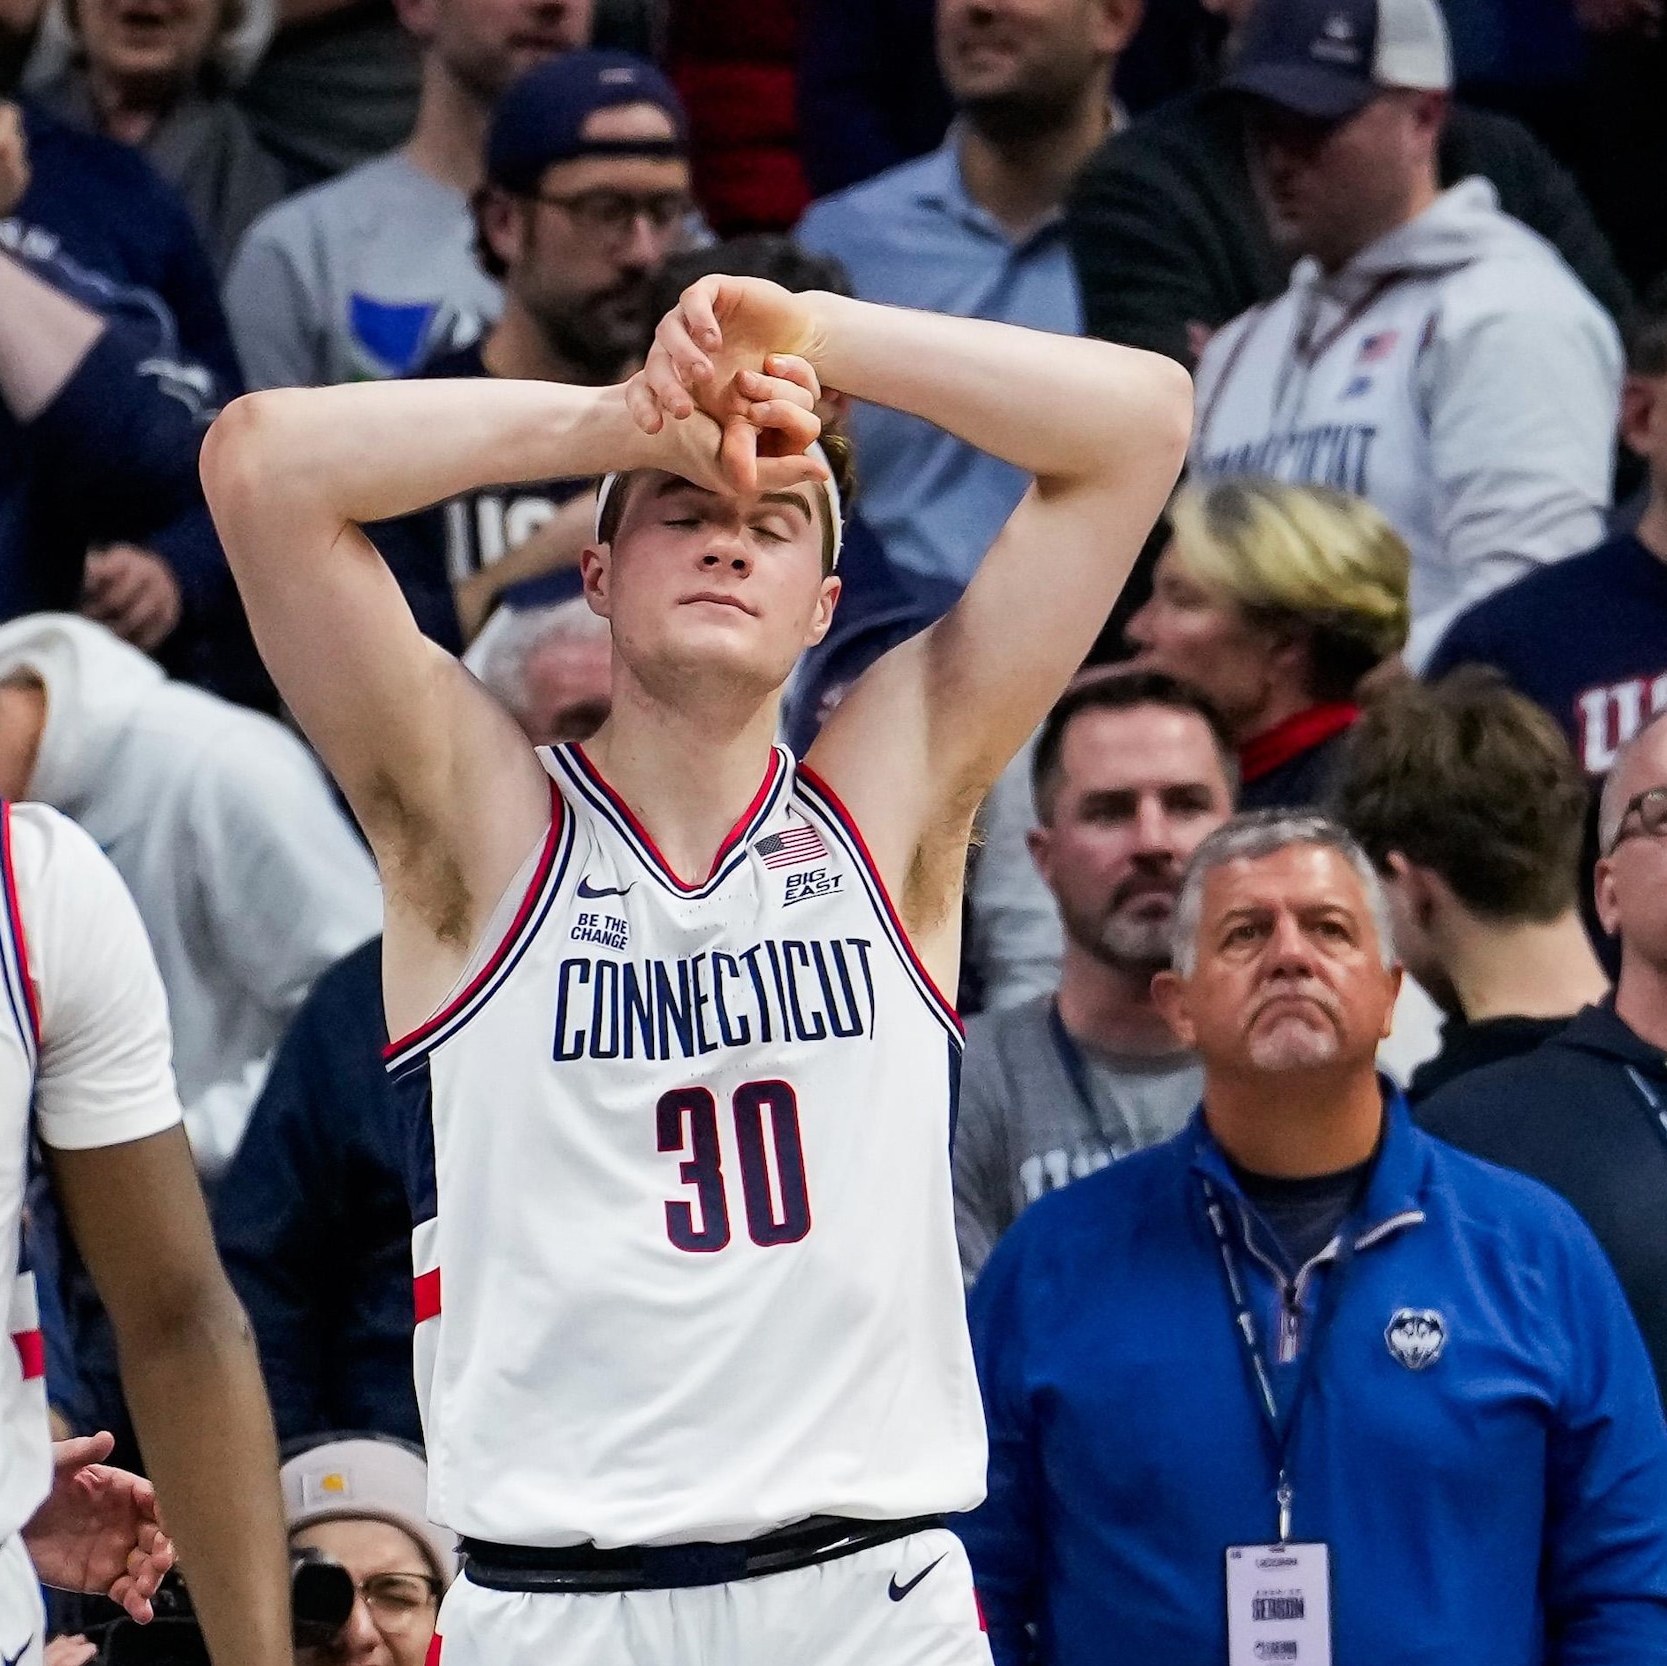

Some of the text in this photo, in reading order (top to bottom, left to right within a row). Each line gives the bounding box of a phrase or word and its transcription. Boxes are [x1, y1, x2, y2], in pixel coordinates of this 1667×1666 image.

[784, 873, 844, 901] EAST
[785, 867, 827, 889] BIG
[577, 912, 629, 935] BE THE
[569, 925, 629, 952] CHANGE
[552, 938, 875, 1063] CONNECTICUT
[656, 1079, 812, 1254] 30
